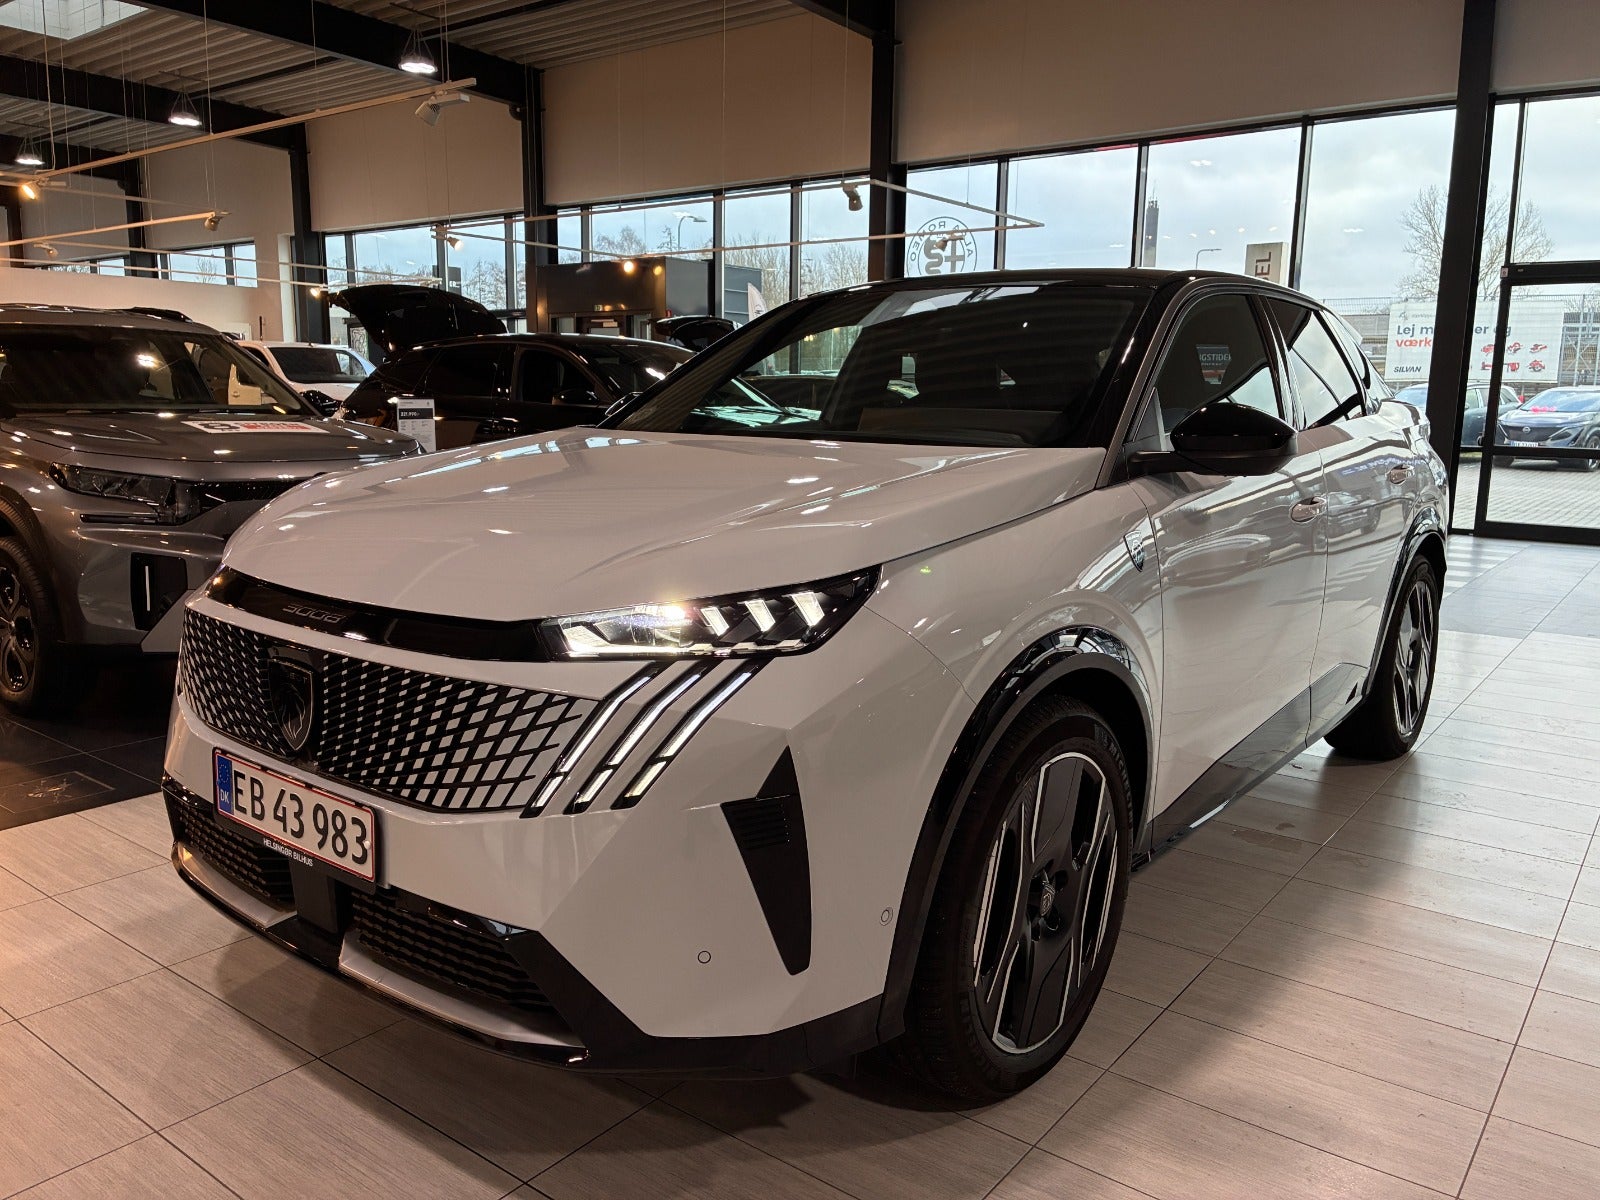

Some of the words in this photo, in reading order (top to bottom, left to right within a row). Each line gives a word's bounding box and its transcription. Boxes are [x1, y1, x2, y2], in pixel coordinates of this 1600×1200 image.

[1255, 251, 1272, 280] EL
[1396, 324, 1415, 338] Lej
[1395, 337, 1432, 348] værk
[282, 603, 347, 624] 3008
[219, 788, 230, 804] DK
[233, 769, 266, 822] EB
[273, 787, 305, 839] 43
[312, 802, 369, 866] 983
[292, 851, 314, 867] BILHUS
